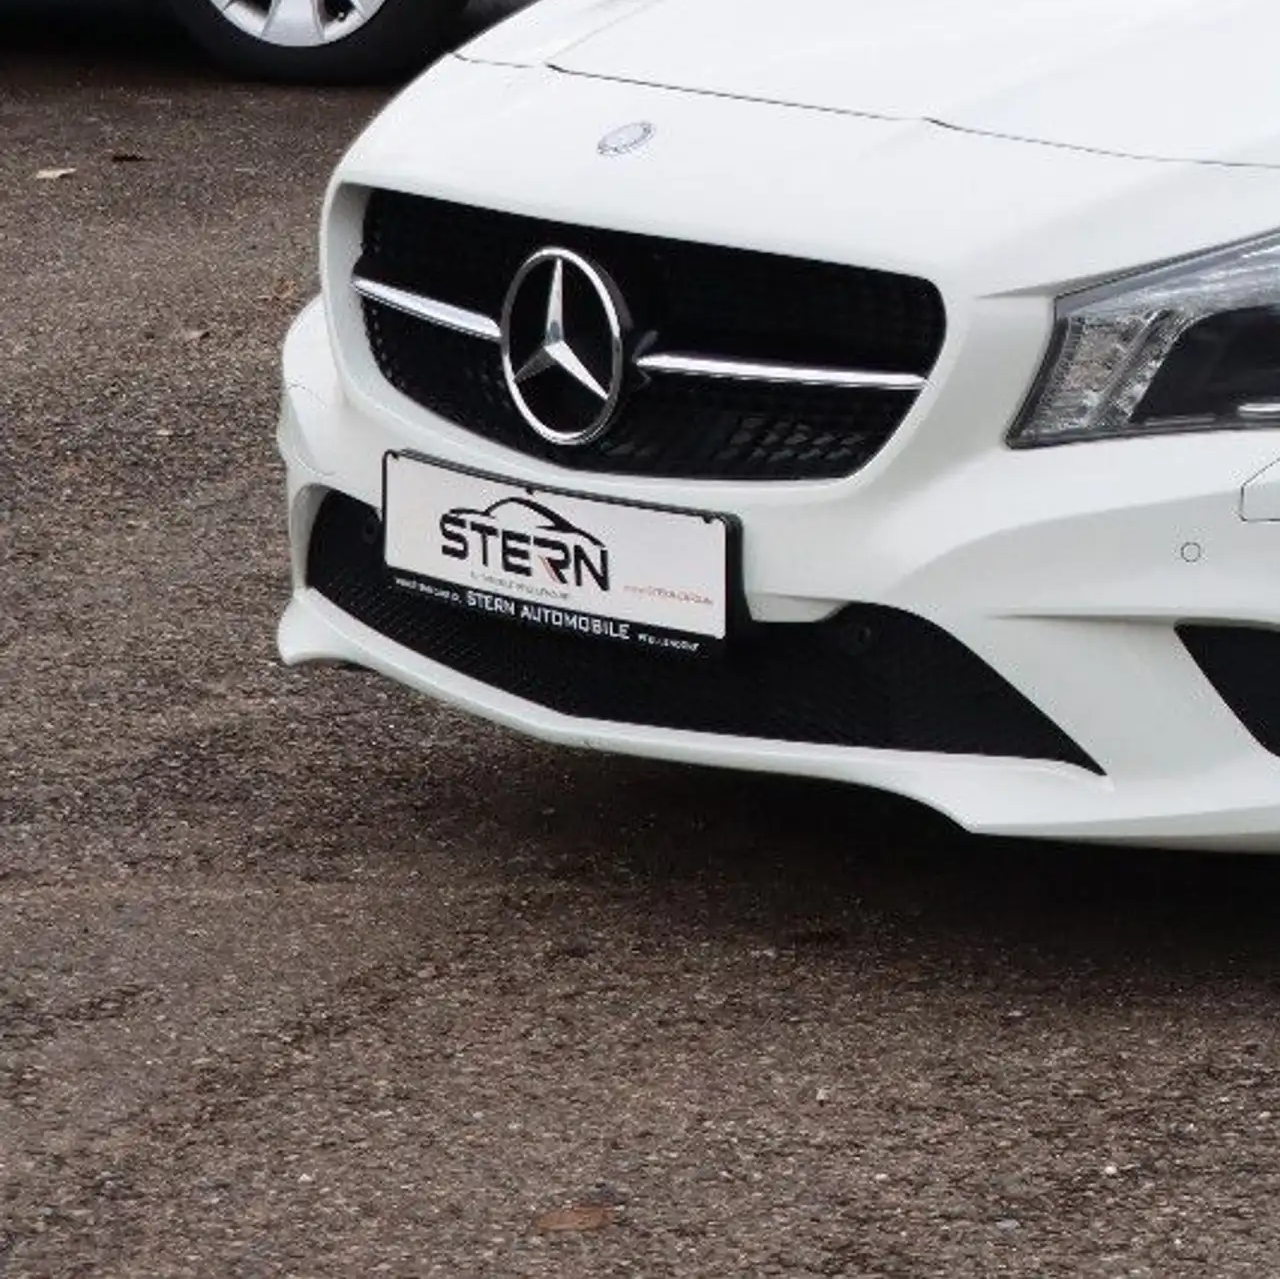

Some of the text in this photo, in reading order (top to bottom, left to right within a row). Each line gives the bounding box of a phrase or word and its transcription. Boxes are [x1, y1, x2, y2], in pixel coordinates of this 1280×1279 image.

[440, 513, 610, 591] STERN
[466, 590, 516, 616] STERN
[520, 603, 631, 641] AUTOMOBILE
